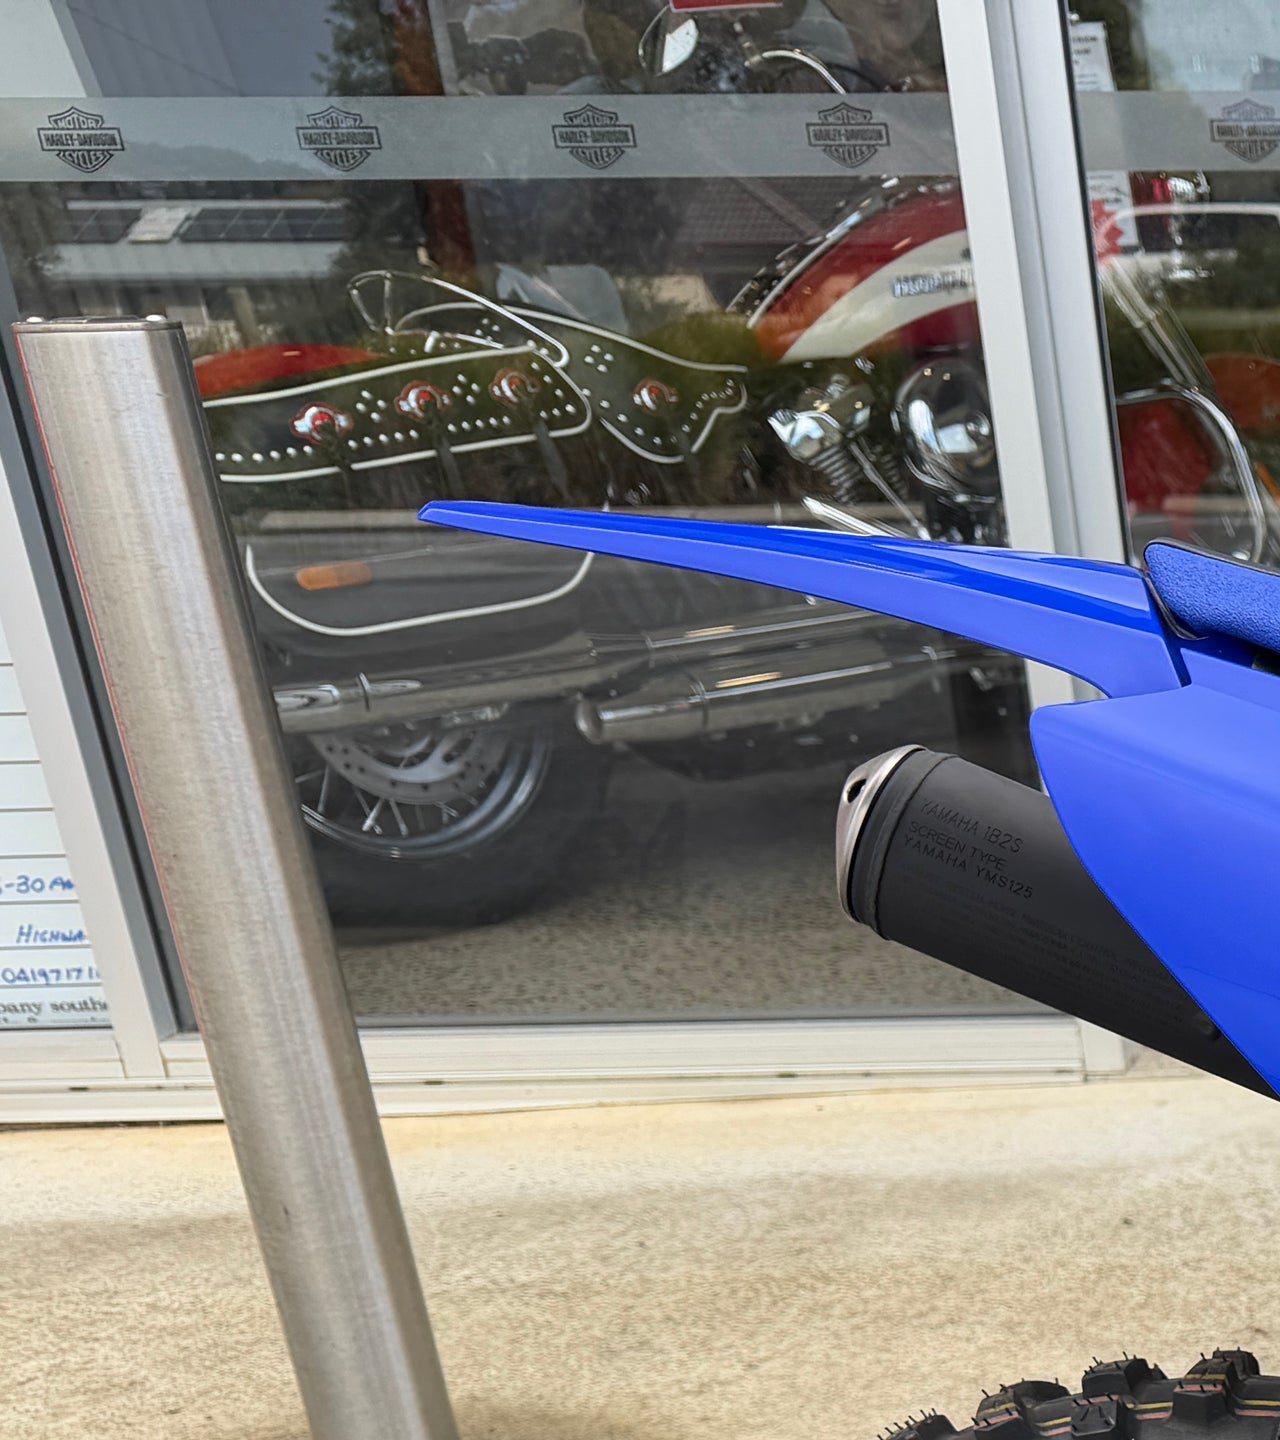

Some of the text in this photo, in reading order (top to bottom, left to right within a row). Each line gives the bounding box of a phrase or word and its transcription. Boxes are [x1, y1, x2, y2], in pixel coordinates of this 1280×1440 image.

[56, 114, 97, 129] MOTOR
[44, 132, 118, 147] HARLEY-DAVIDSON
[64, 150, 107, 169] CYCLES
[919, 799, 980, 834] YAMAHA
[908, 819, 1008, 872] SCREEN TYPE
[904, 834, 1034, 899] YAMAHA YMS125
